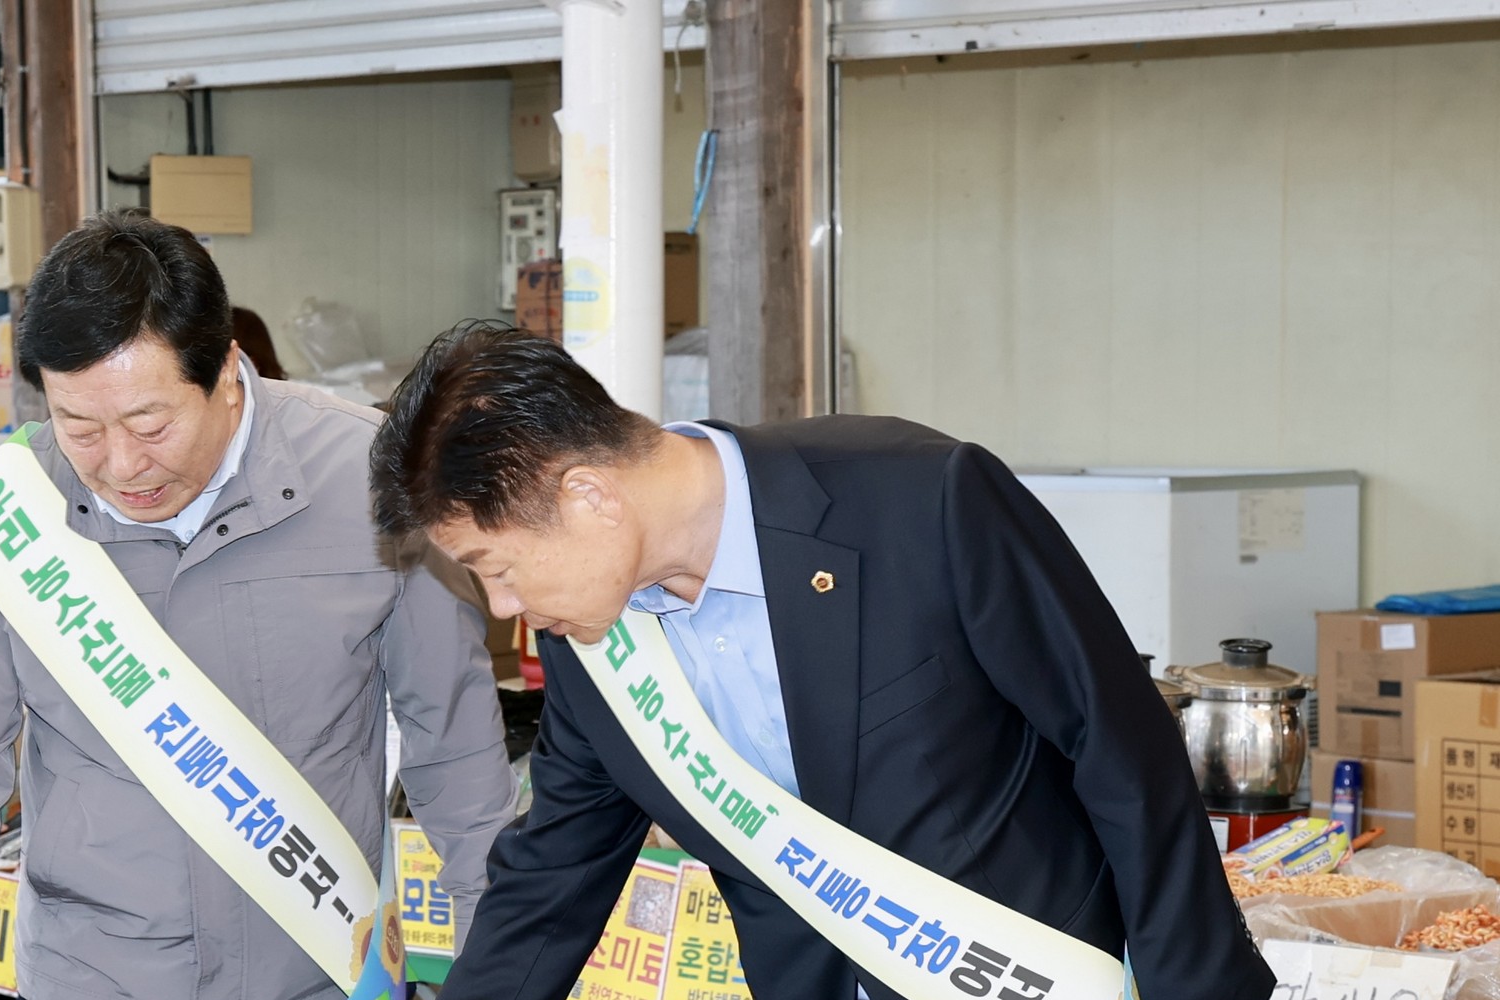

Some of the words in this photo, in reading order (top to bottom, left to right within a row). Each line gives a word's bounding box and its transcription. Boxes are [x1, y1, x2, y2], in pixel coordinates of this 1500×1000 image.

[20, 555, 170, 708] 농수산물,
[144, 702, 354, 924] 전통시장에서!
[627, 673, 779, 840] 농수산물,
[686, 888, 732, 924] 마법
